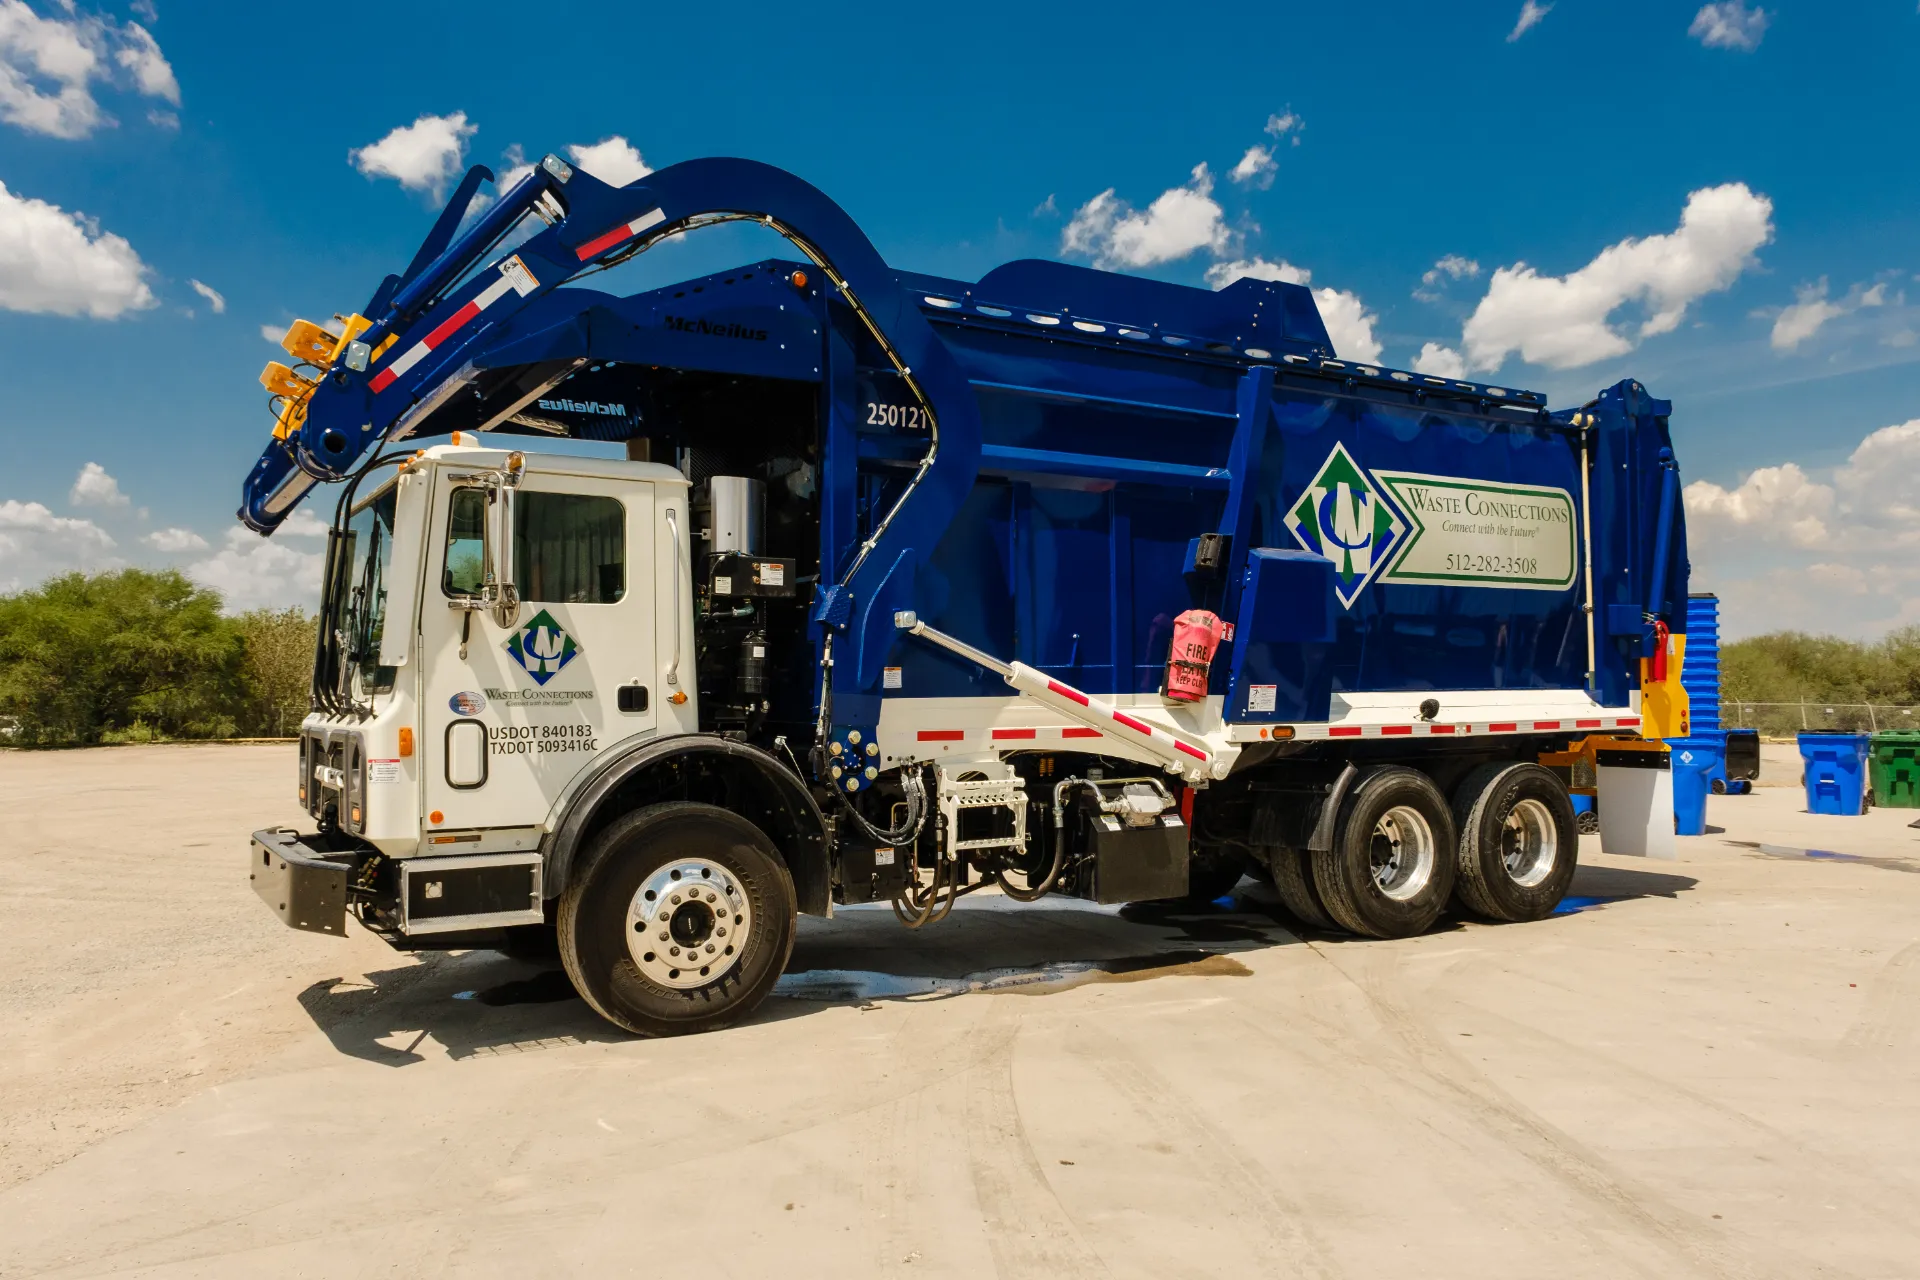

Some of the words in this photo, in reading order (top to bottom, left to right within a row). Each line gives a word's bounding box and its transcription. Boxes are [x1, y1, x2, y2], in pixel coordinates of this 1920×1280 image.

[664, 315, 770, 342] McNeilus
[866, 402, 927, 430] 250121
[1407, 487, 1462, 515] WASTE
[1465, 492, 1569, 523] CONNECTIONS
[1441, 519, 1476, 534] Connect
[1477, 523, 1495, 535] with
[1496, 524, 1509, 536] the
[1445, 553, 1537, 575] 512-282-3508
[1186, 643, 1208, 661] FIRE
[1176, 675, 1191, 686] KEEP
[483, 688, 520, 700] WASTE
[522, 688, 594, 700] CONNECTIONS
[489, 726, 539, 740] USDOT
[541, 724, 592, 739] 840183
[490, 741, 534, 755] TXDOT
[537, 738, 599, 753] 5093416C
